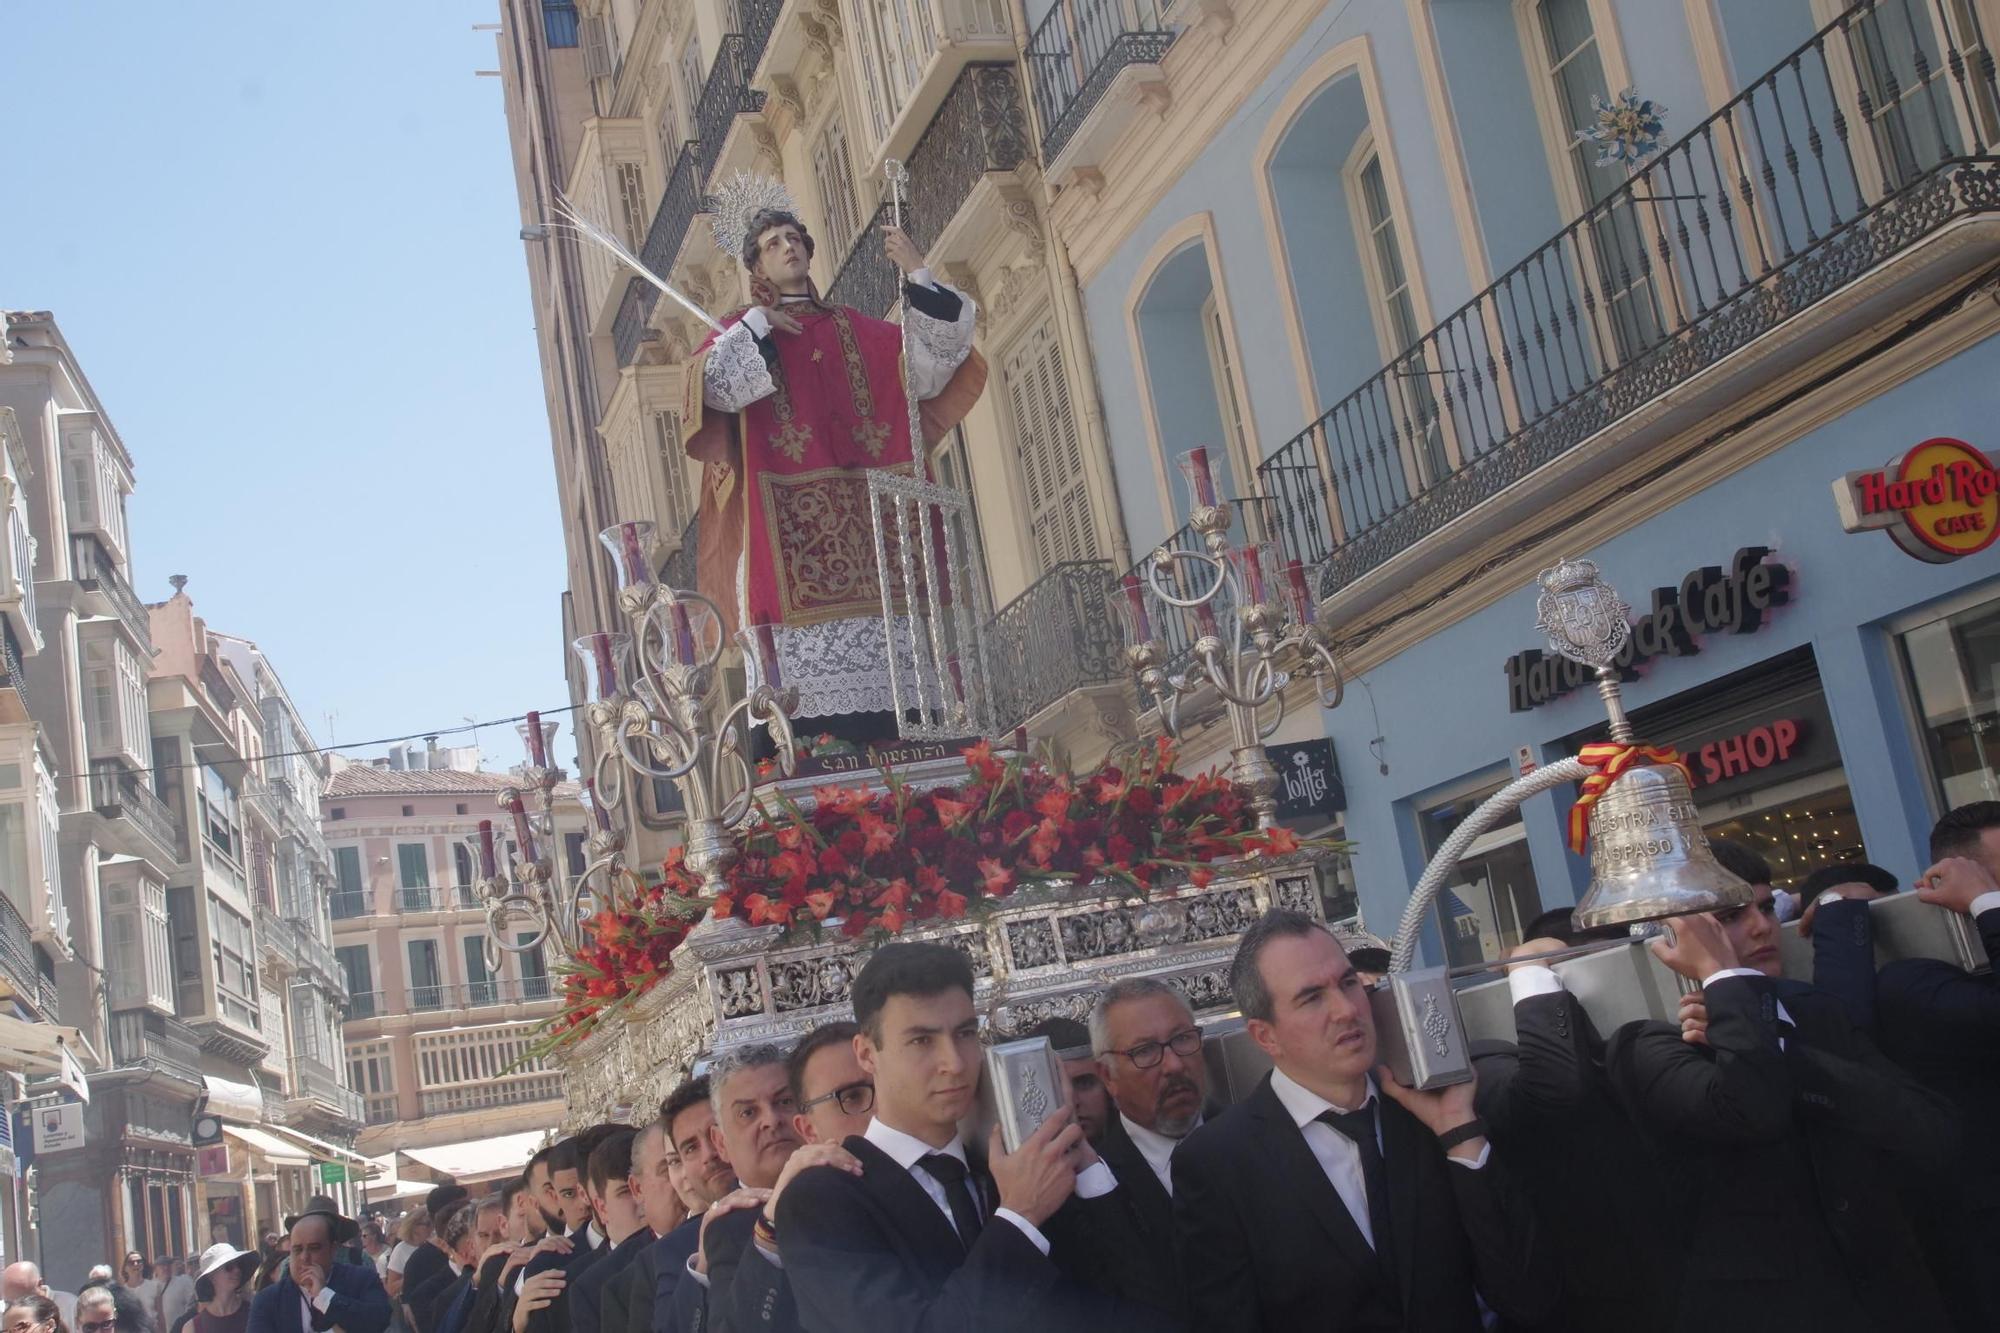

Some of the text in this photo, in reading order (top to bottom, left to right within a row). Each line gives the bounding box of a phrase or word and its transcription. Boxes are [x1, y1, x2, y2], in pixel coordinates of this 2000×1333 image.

[1856, 459, 2000, 516] Hard Ro
[1933, 511, 1986, 537] CAFE
[821, 754, 859, 771] SAN
[1701, 719, 1797, 784] SHOP
[1681, 833, 1692, 850] Y
